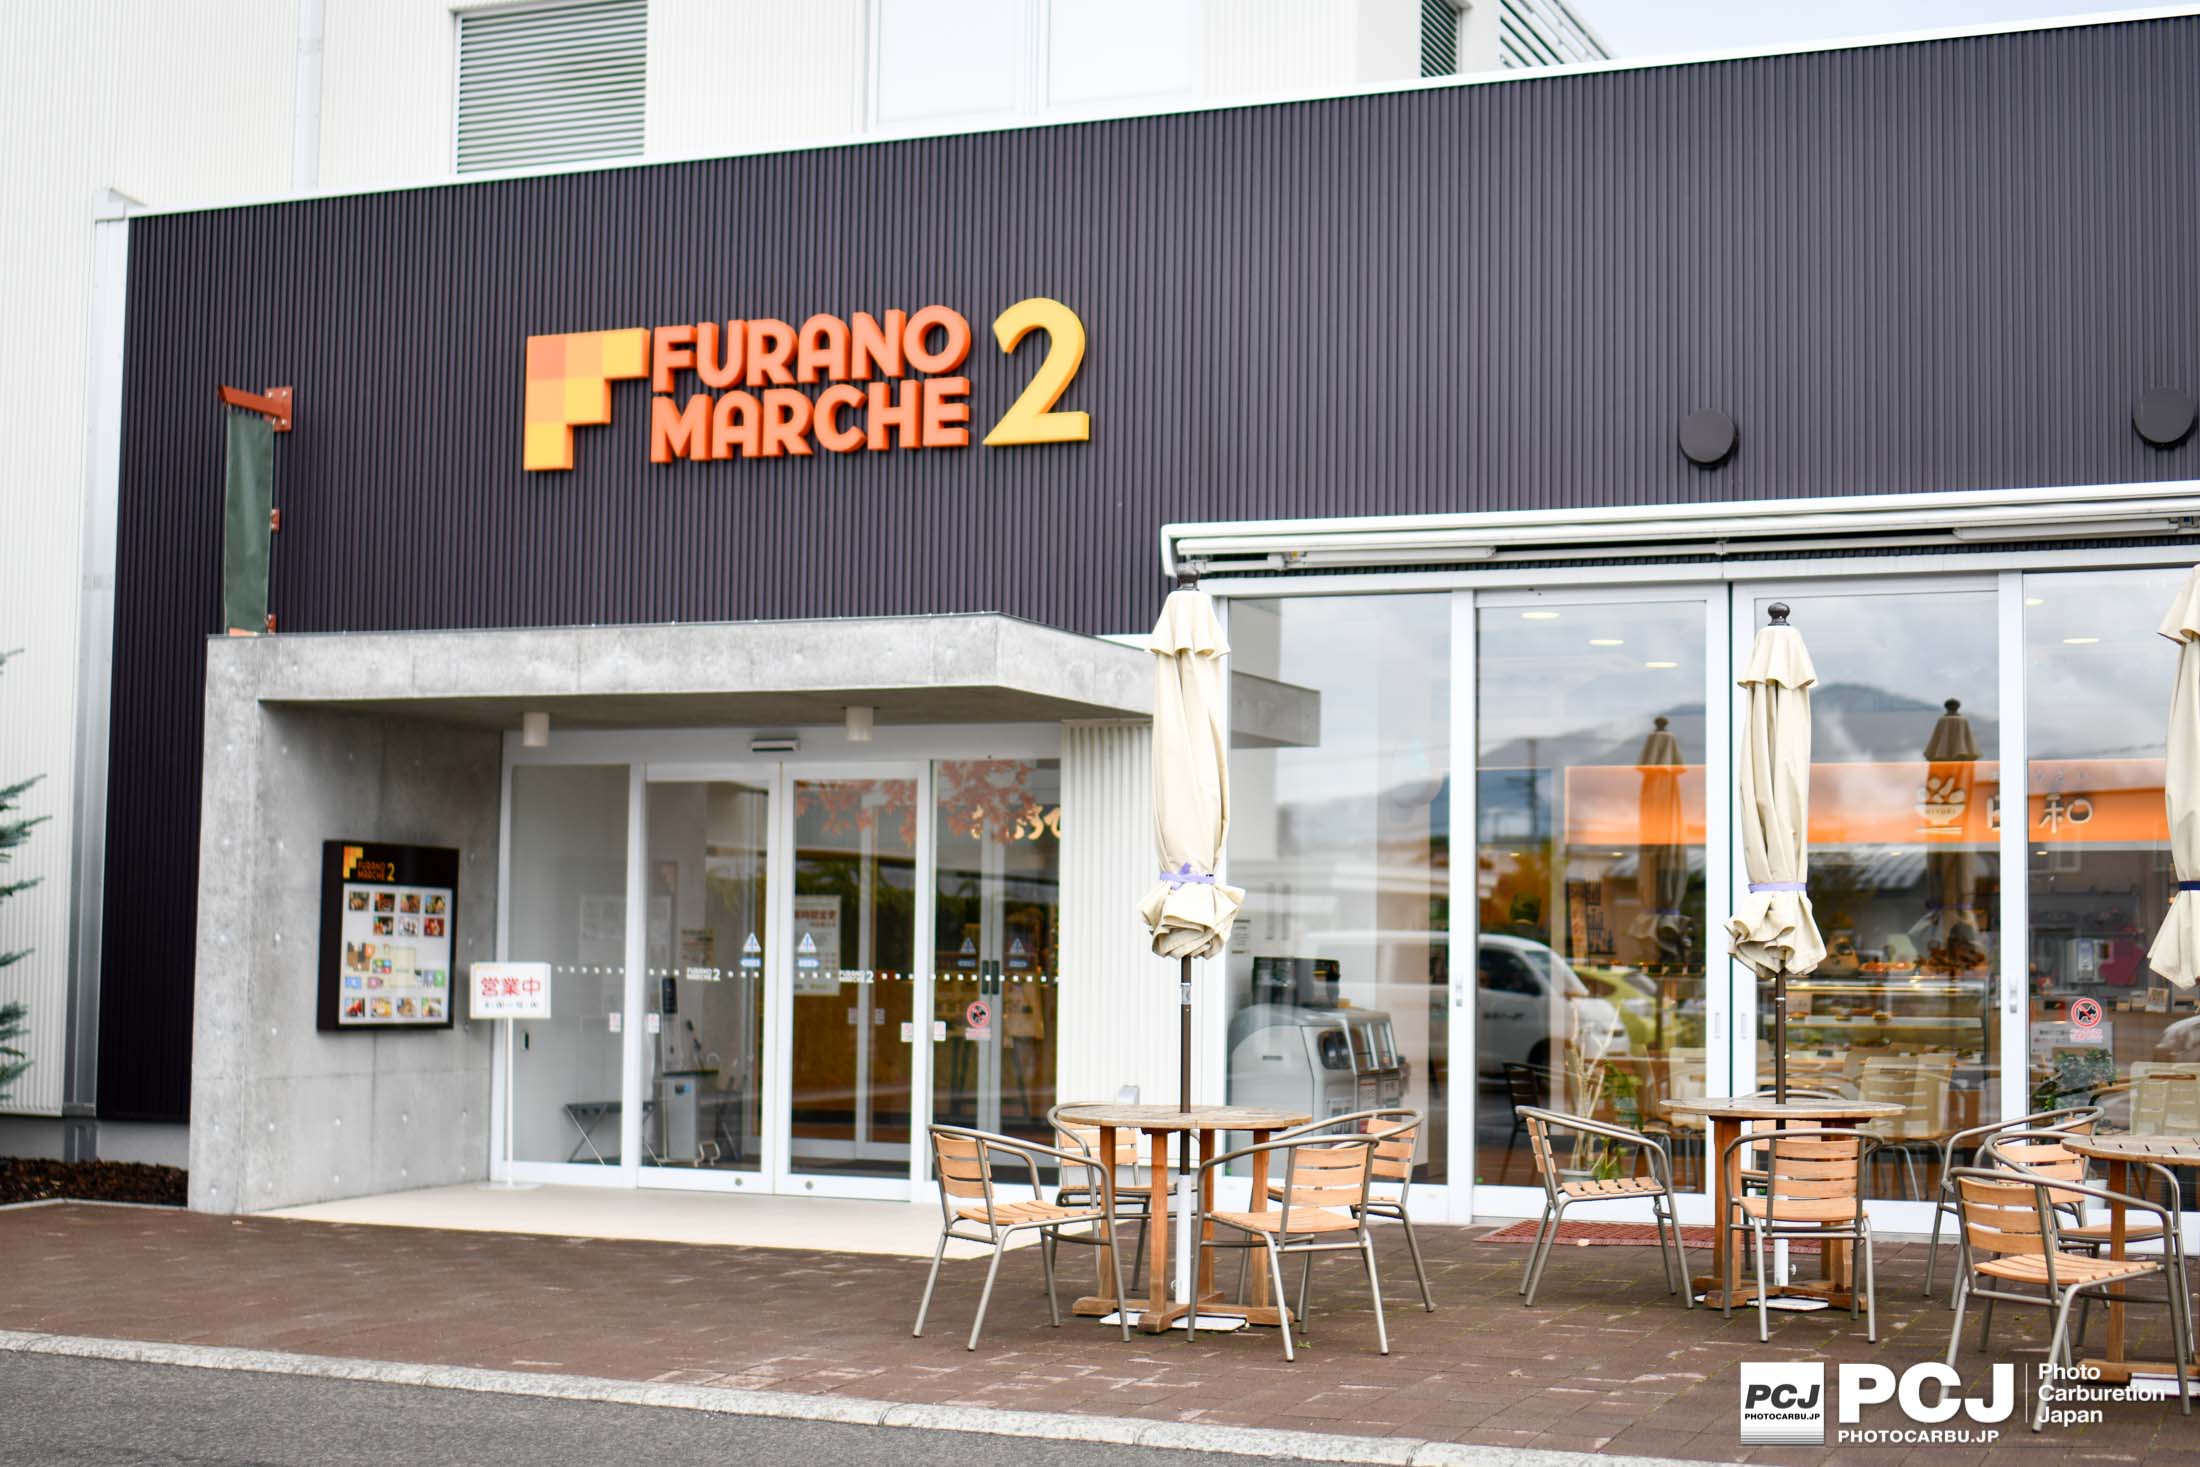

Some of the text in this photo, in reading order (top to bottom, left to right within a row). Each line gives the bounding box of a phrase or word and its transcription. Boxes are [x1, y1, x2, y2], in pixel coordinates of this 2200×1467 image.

[652, 304, 972, 393] FURANO
[982, 297, 1090, 447] 2
[650, 376, 971, 464] MARCHE
[480, 975, 542, 998] 営業中
